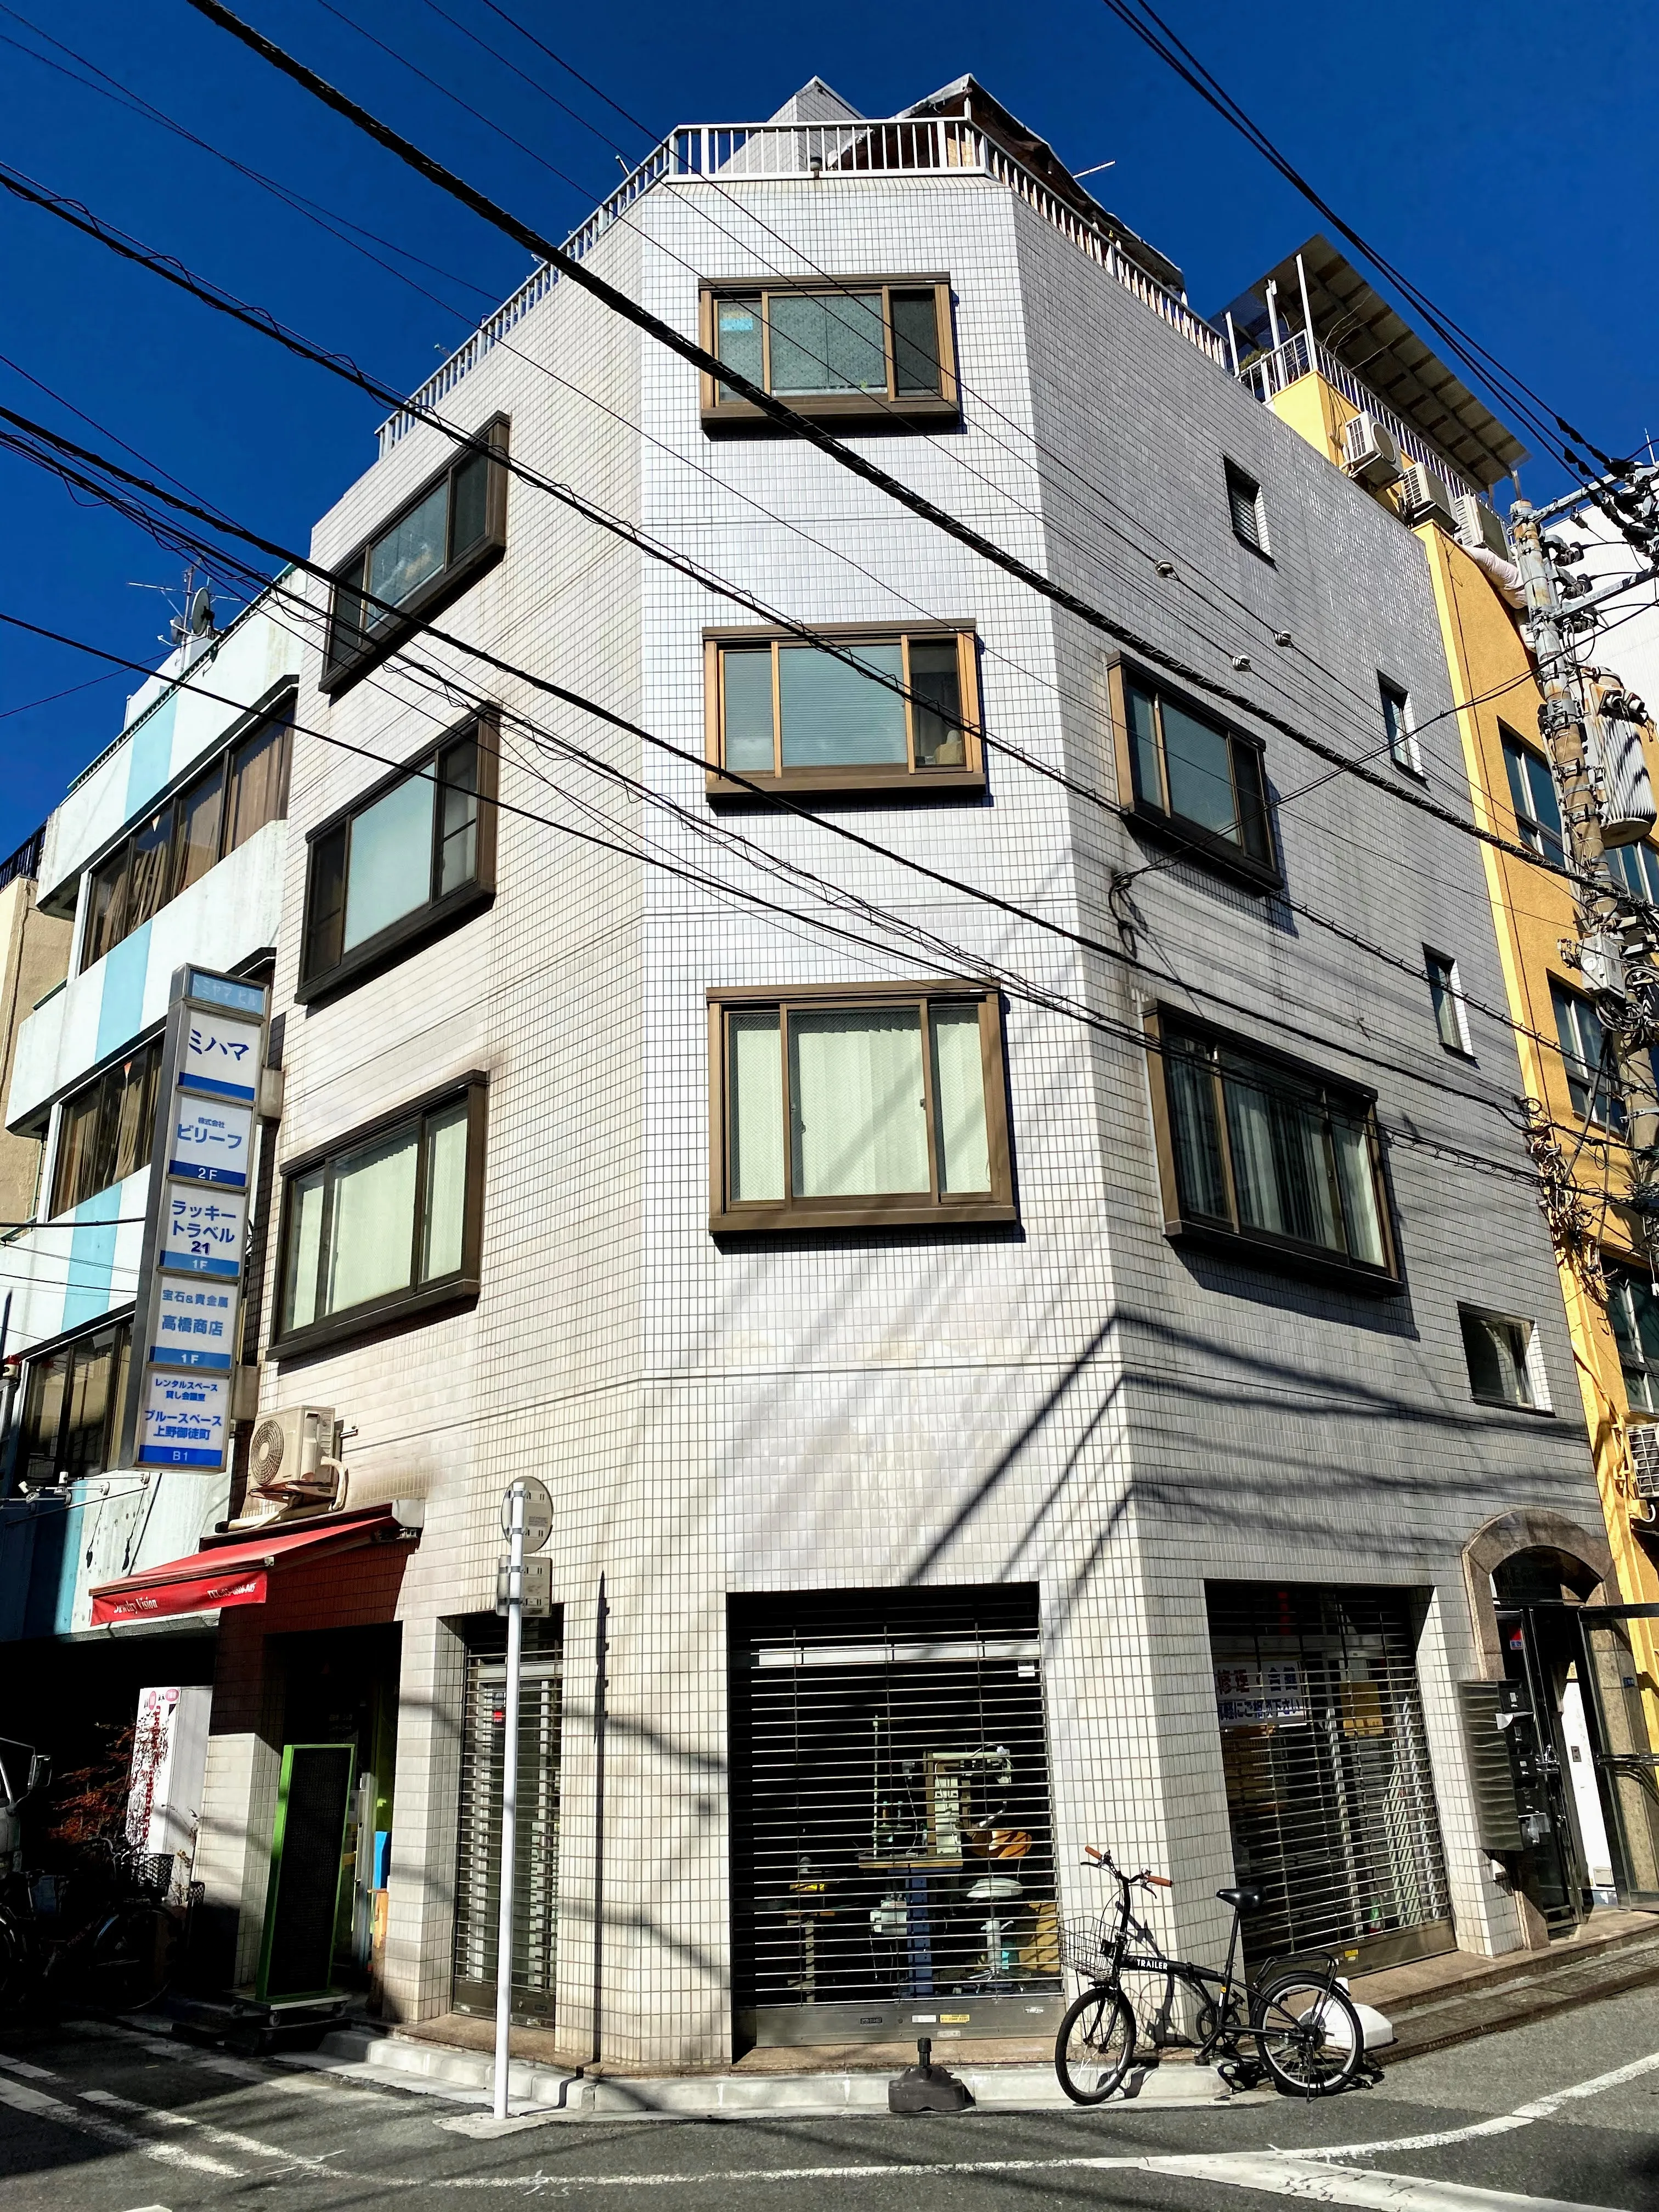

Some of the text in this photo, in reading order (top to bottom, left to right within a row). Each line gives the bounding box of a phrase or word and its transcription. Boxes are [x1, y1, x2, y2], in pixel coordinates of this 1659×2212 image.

[189, 1029, 249, 1060] ミハマ
[198, 1117, 225, 1128] 株式会社
[177, 1124, 242, 1149] ビリーフ
[198, 1167, 217, 1180] 2F
[172, 1200, 236, 1221] ラッキー
[173, 1220, 235, 1243] トラベル
[191, 1241, 210, 1255] 21
[193, 1260, 208, 1269] 1F
[162, 1315, 223, 1336] 高橋商店
[181, 1354, 199, 1364] 1F
[156, 1379, 218, 1391] レンタルスペース
[145, 1409, 222, 1426] ブルースペース
[153, 1425, 211, 1440] 上野御徒町
[173, 1451, 188, 1460] B1
[135, 1596, 159, 1610] Vision
[1137, 1959, 1168, 1970] TRAILER
